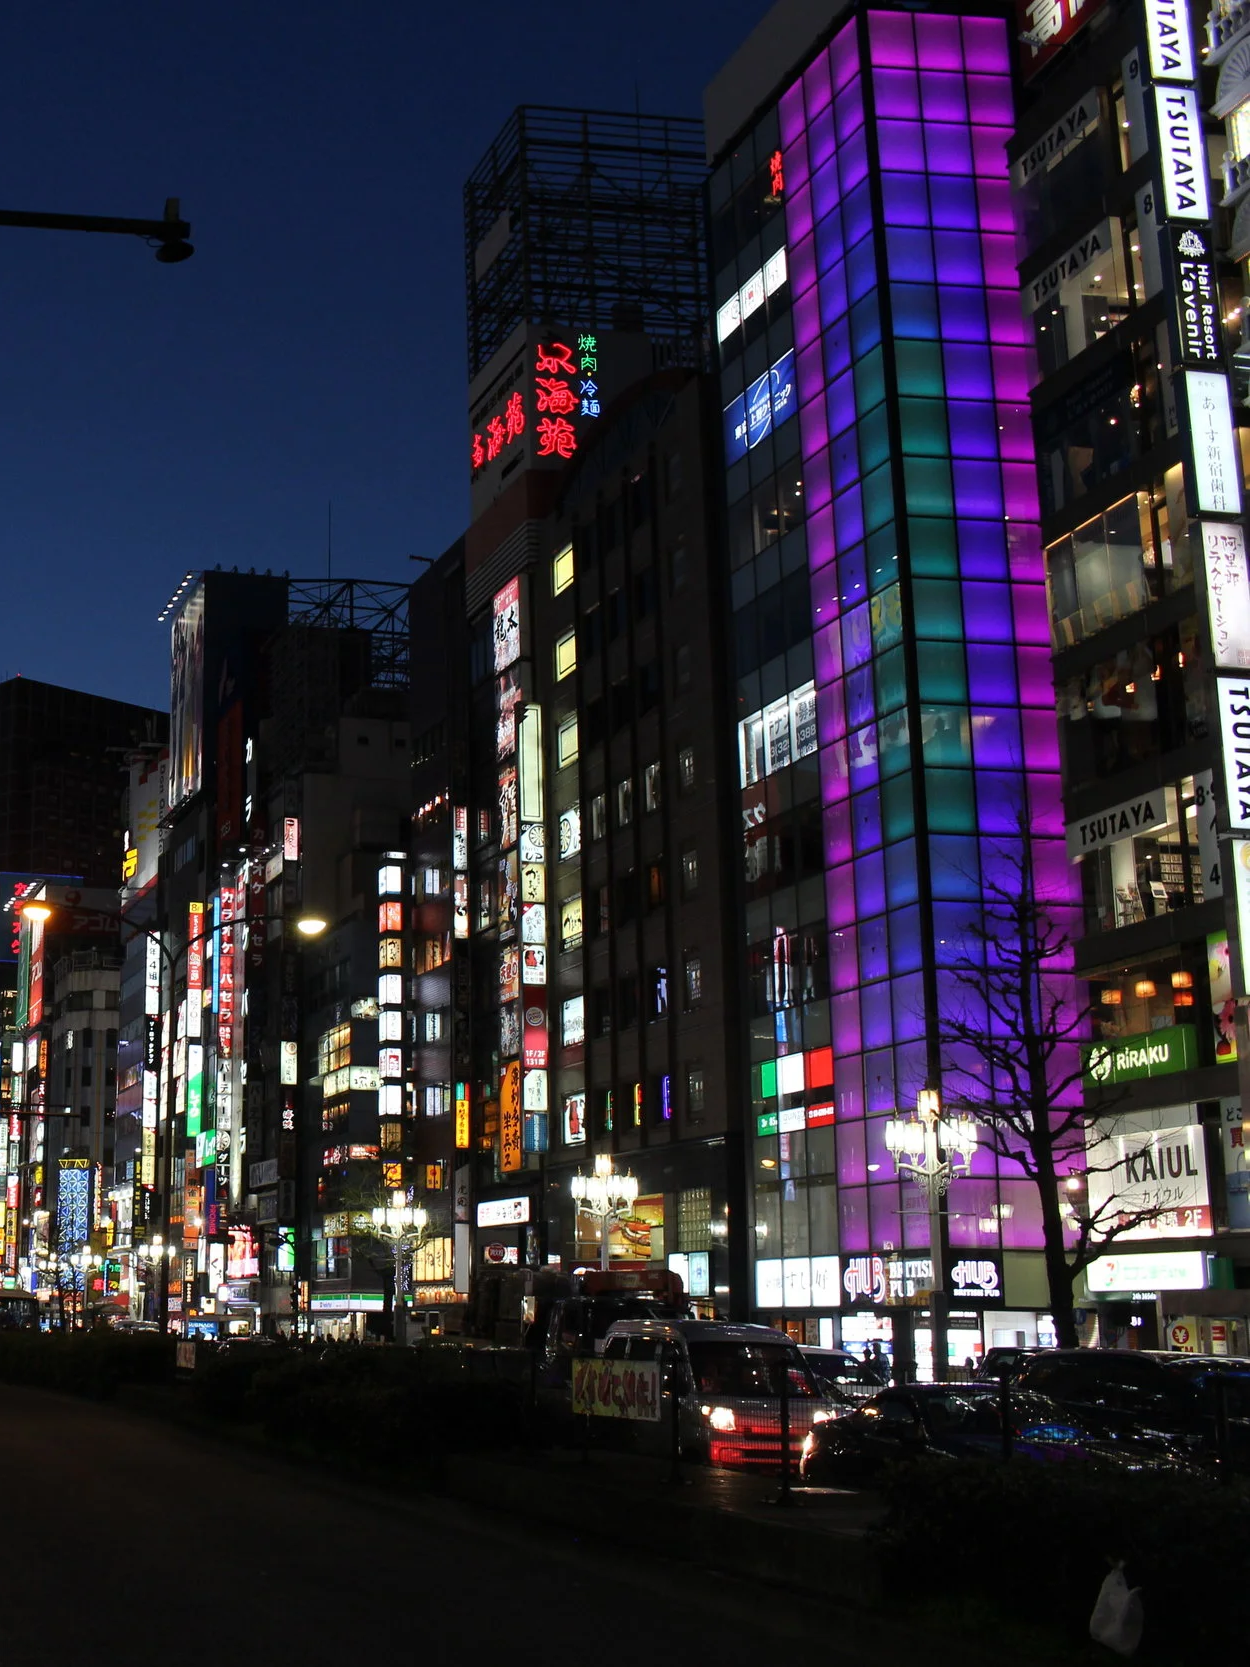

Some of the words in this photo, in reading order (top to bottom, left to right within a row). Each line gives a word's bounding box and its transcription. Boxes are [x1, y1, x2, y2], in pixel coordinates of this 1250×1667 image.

[1156, 0, 1181, 71] TAYA
[1129, 58, 1138, 80] 9
[1021, 104, 1088, 178] TSUTAYA
[1166, 95, 1197, 211] TSUTAYA
[1144, 193, 1153, 216] 8
[1032, 232, 1101, 304] TSUTAYA
[1196, 264, 1210, 299] Hair
[1179, 262, 1202, 359] L'avenir
[1201, 303, 1218, 360] Resort
[1207, 534, 1230, 655] リラクゼーション
[157, 799, 166, 854] Quote
[1080, 800, 1155, 846] TSUTAYA
[1209, 863, 1220, 885] 4
[72, 914, 118, 932] アコム
[221, 890, 234, 954] カラオケ
[1116, 1043, 1169, 1070] RiRAKU
[204, 1139, 217, 1158] レイ
[1125, 1144, 1198, 1184] KAIUL
[217, 1153, 228, 1185] ダーツ
[1142, 1187, 1184, 1206] カイウル
[209, 1204, 218, 1235] PROMISE
[1185, 1208, 1202, 1226] 2F
[844, 1256, 886, 1304] HUB
[889, 1279, 915, 1298] PUB
[951, 1260, 999, 1290] HUB
[953, 1288, 984, 1297] BRITISH
[984, 1288, 1000, 1298] PUB
